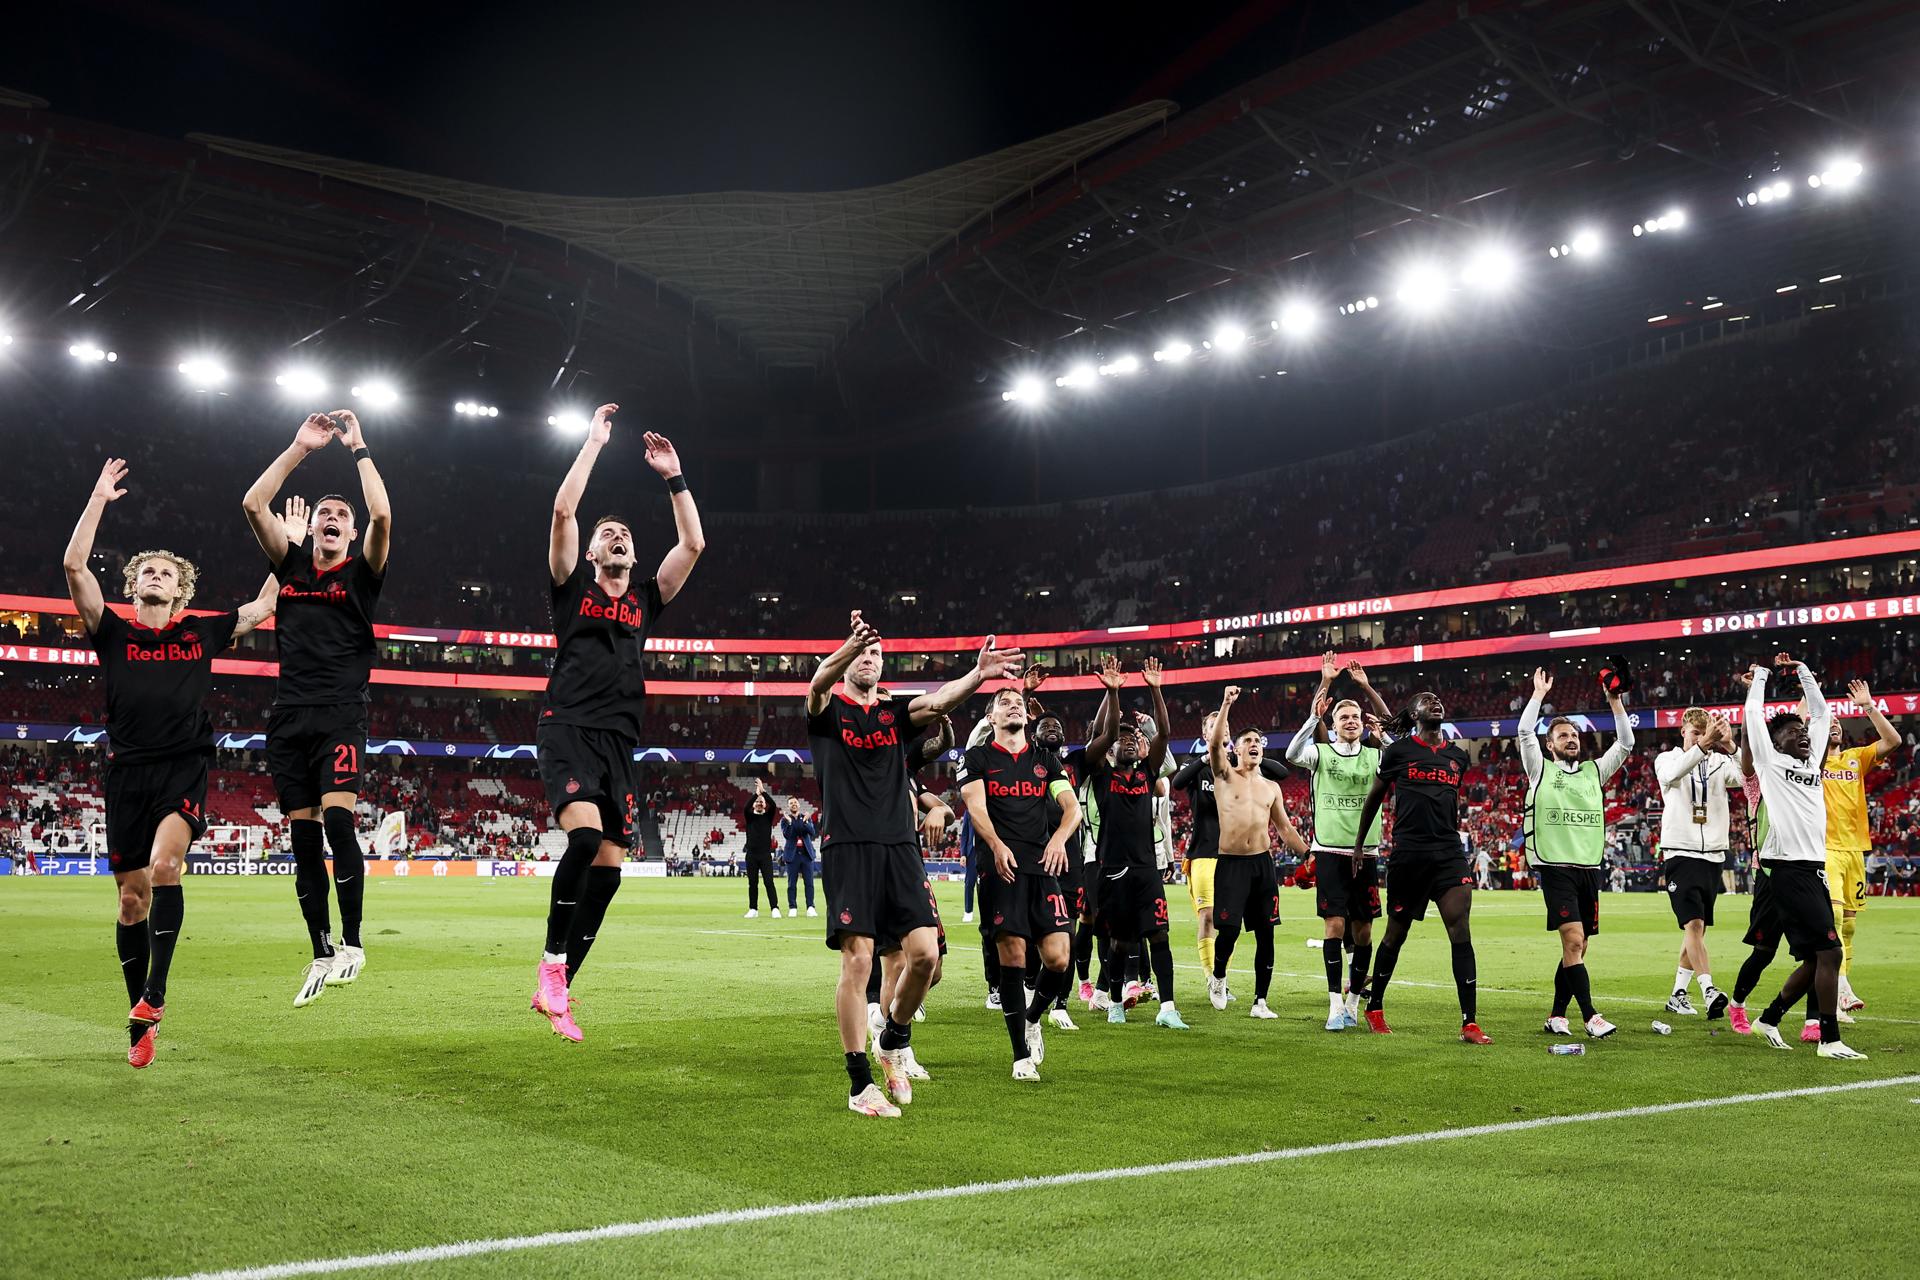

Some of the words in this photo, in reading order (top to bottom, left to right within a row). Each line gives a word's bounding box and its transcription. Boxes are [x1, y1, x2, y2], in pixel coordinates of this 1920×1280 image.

[580, 597, 618, 620] Red
[619, 603, 642, 628] Bull
[1216, 615, 1257, 631] SPORT
[1262, 609, 1311, 626] LISBOA
[1317, 607, 1324, 619] E
[1330, 598, 1392, 618] BENFICA
[1702, 613, 1768, 633] SPORT
[1777, 604, 1855, 625] LISBOA
[1866, 602, 1876, 617] E
[499, 633, 553, 647] SPORT
[644, 638, 715, 651] BENFICA
[29, 648, 38, 661] E
[127, 644, 165, 661] Red
[168, 643, 202, 661] Bull
[842, 728, 874, 749] Red
[334, 744, 358, 773] 21
[1408, 767, 1437, 780] Red
[1785, 769, 1815, 786] Red
[1821, 768, 1843, 780] Red
[988, 780, 1020, 797] Red
[1021, 781, 1047, 797] Bull
[193, 862, 298, 875] mastercar
[491, 862, 537, 876] FedEx
